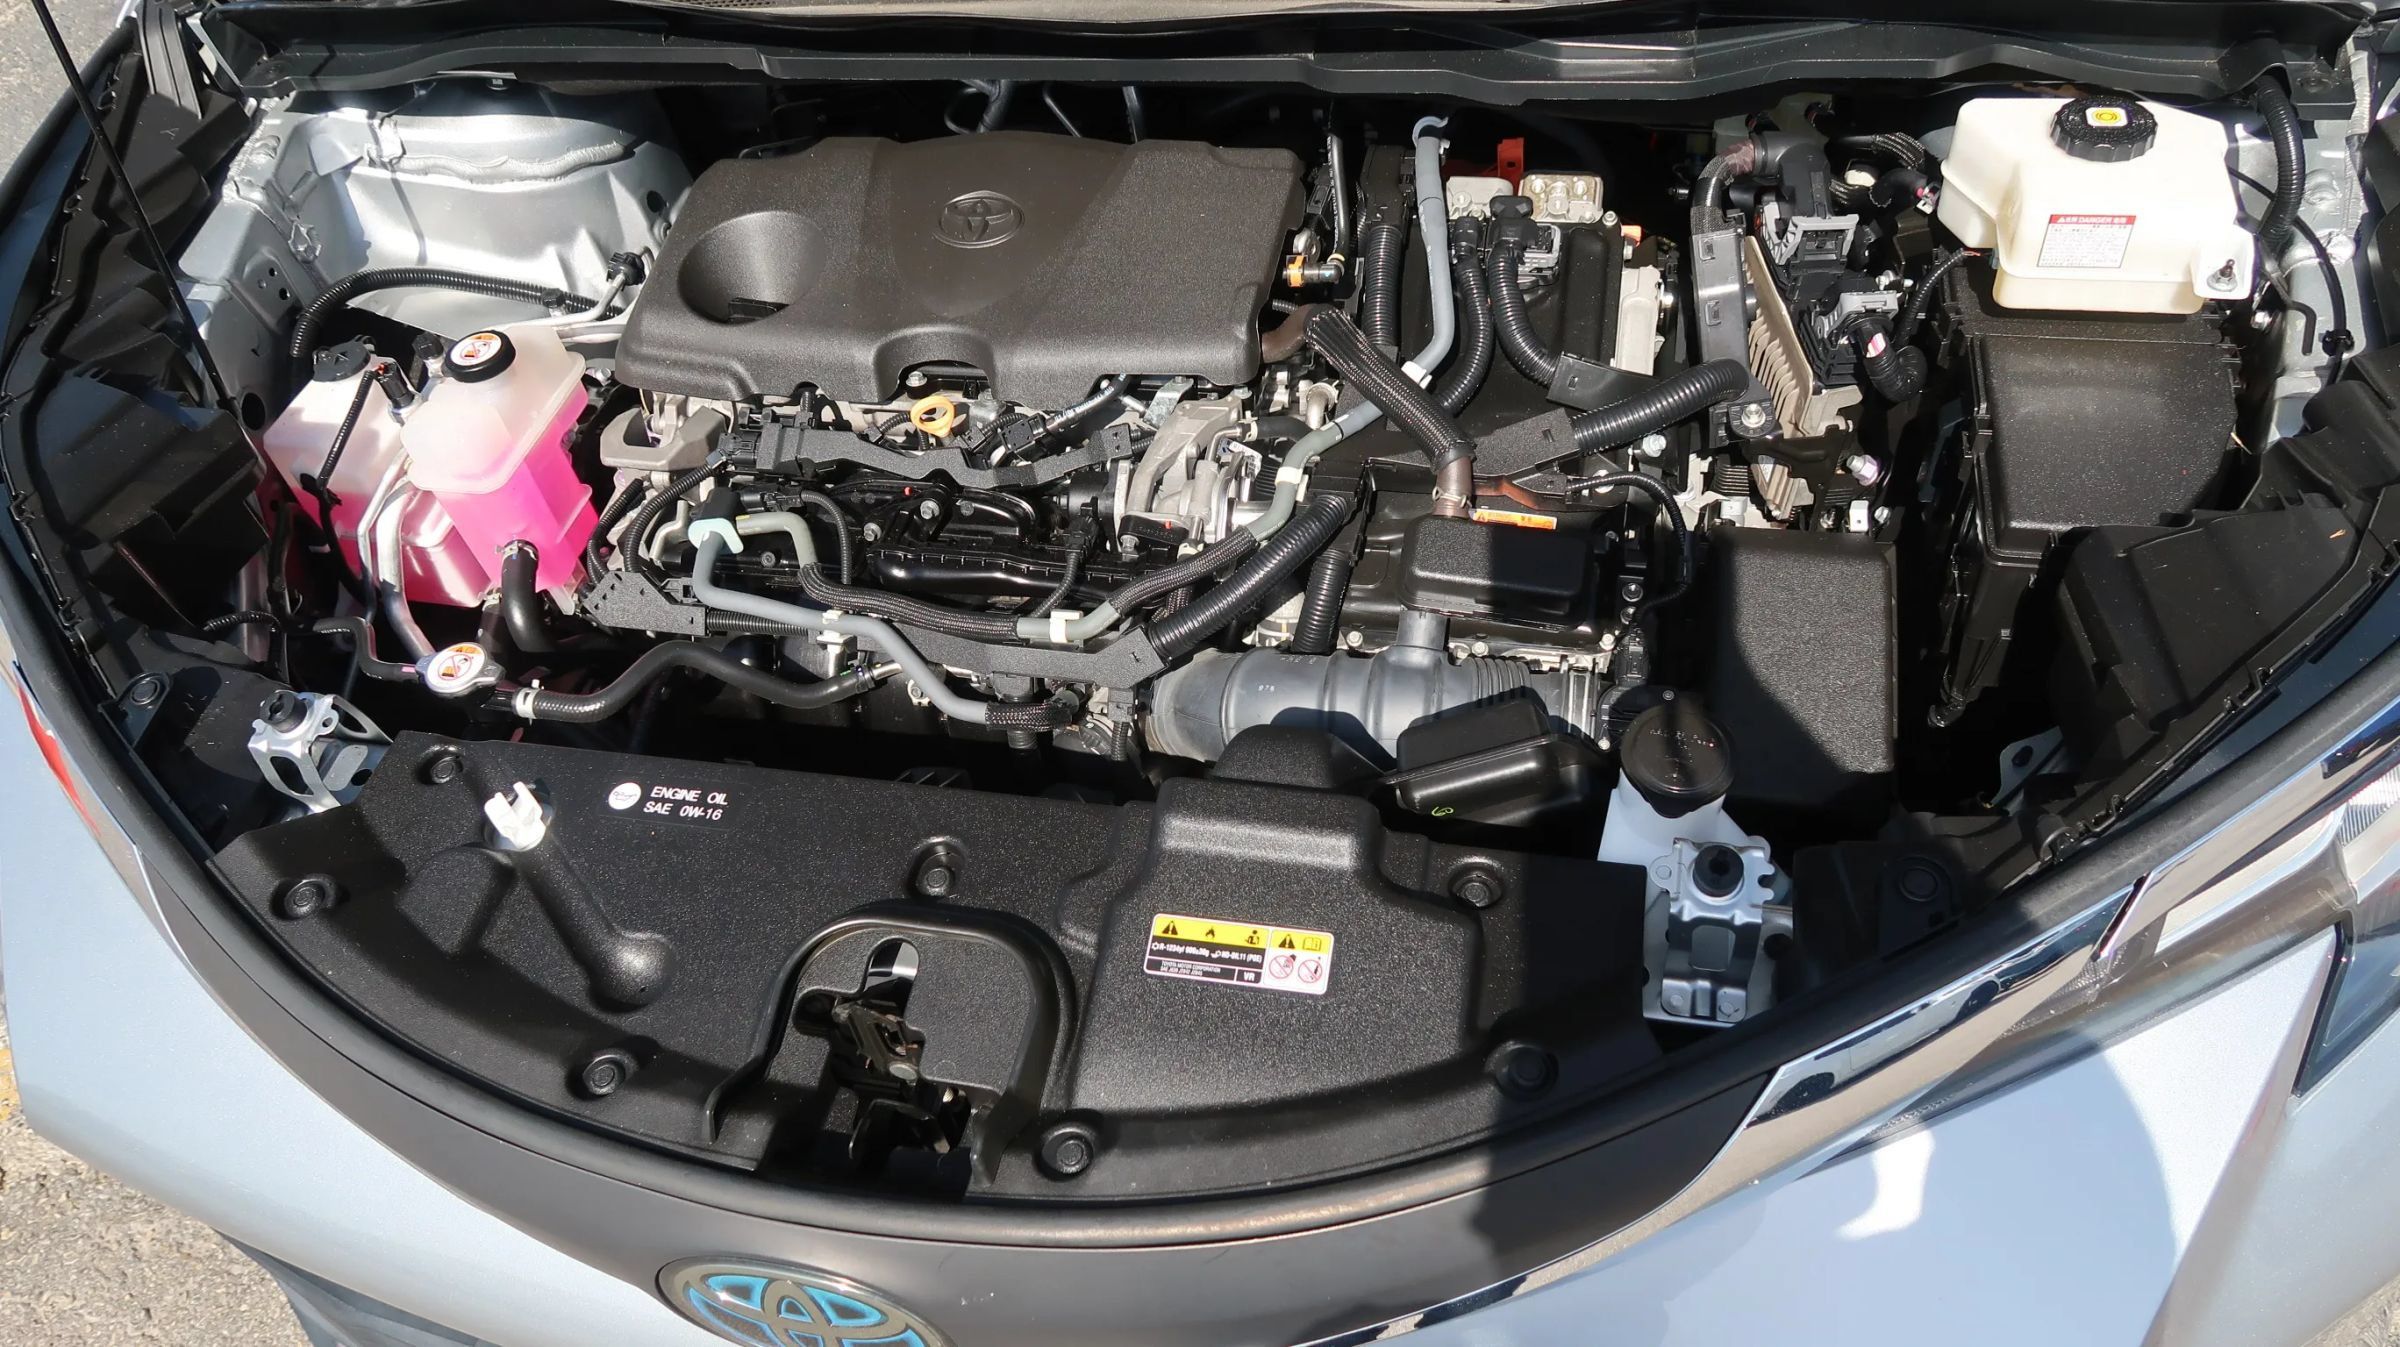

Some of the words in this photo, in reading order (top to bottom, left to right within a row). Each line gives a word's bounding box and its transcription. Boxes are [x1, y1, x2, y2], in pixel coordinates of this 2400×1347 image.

[650, 786, 701, 802] ENGINE
[706, 792, 728, 805] OIL
[643, 801, 673, 815] SAE
[679, 805, 723, 820] 0W-16
[1161, 960, 1177, 968] TOYOTA
[1192, 964, 1221, 973] CORPORATION
[1243, 972, 1255, 981] VR
